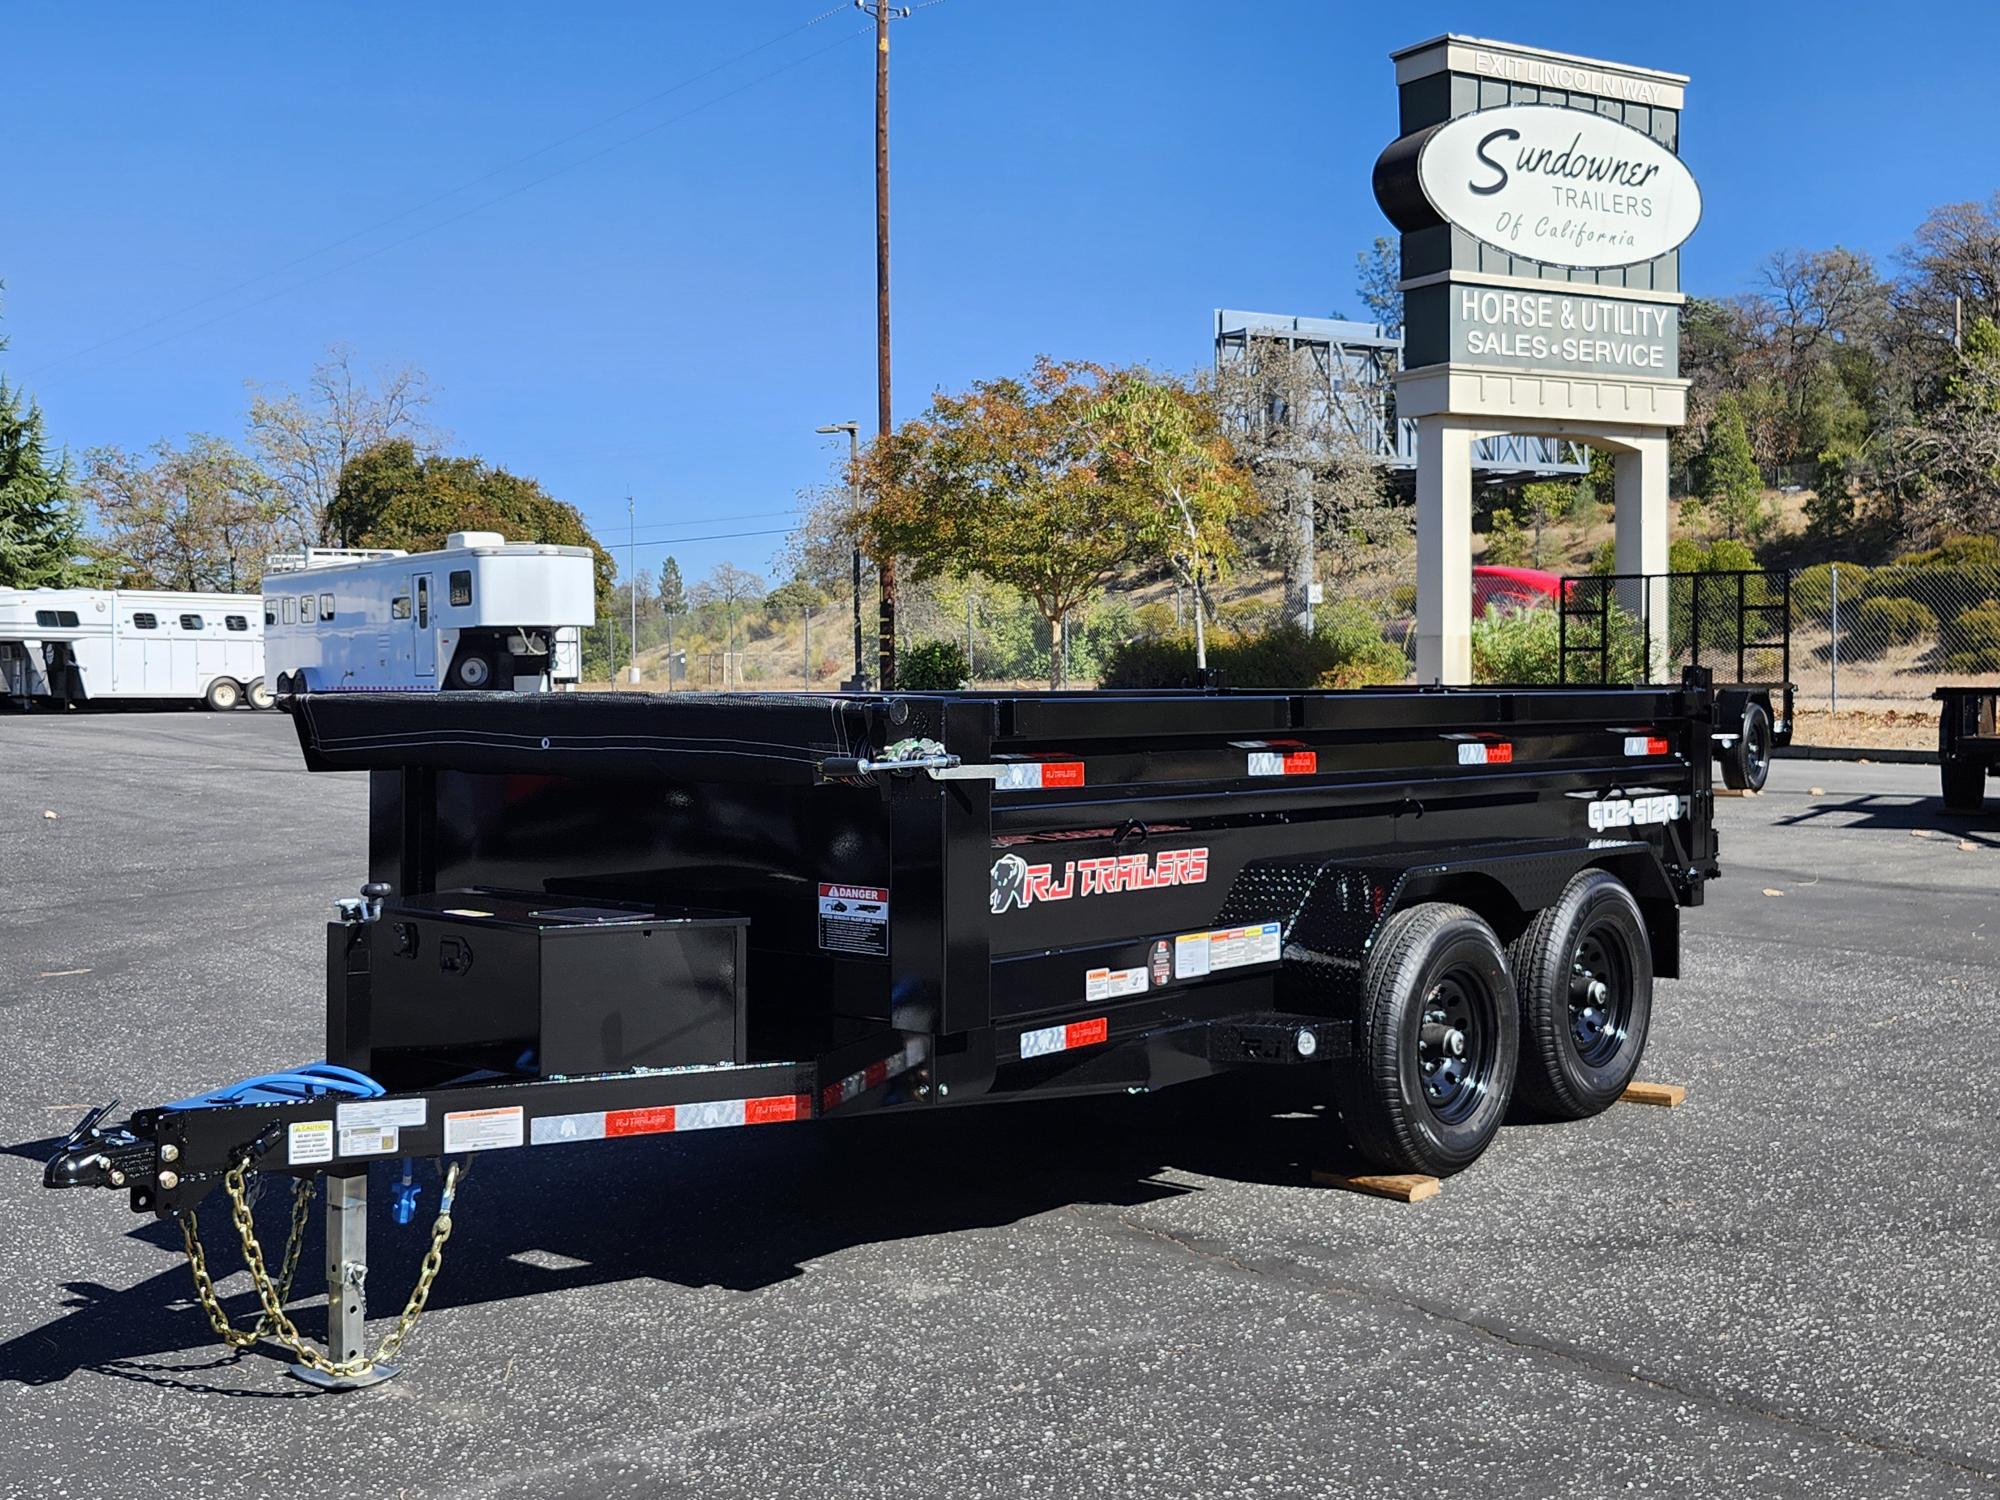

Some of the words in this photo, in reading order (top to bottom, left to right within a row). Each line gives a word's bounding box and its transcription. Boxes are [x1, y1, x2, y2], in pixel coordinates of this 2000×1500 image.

[1474, 52, 1523, 78] EXIT
[1527, 62, 1615, 97] LINCOLN
[1619, 77, 1662, 105] WAY
[1468, 128, 1660, 196] Sundowner
[1552, 186, 1653, 218] TRAILERS
[1496, 211, 1523, 241] Of
[1535, 216, 1635, 248] California
[1461, 289, 1553, 328] HORSE
[1560, 299, 1576, 328] &
[1581, 303, 1669, 338] UTILITY
[1467, 329, 1548, 360] SALES
[1562, 338, 1665, 368] SERVICE
[840, 888, 878, 900] DANGER
[1023, 861, 1075, 903] RJ
[1077, 848, 1209, 896] TRAILERS
[630, 1114, 666, 1126] TRAILERS
